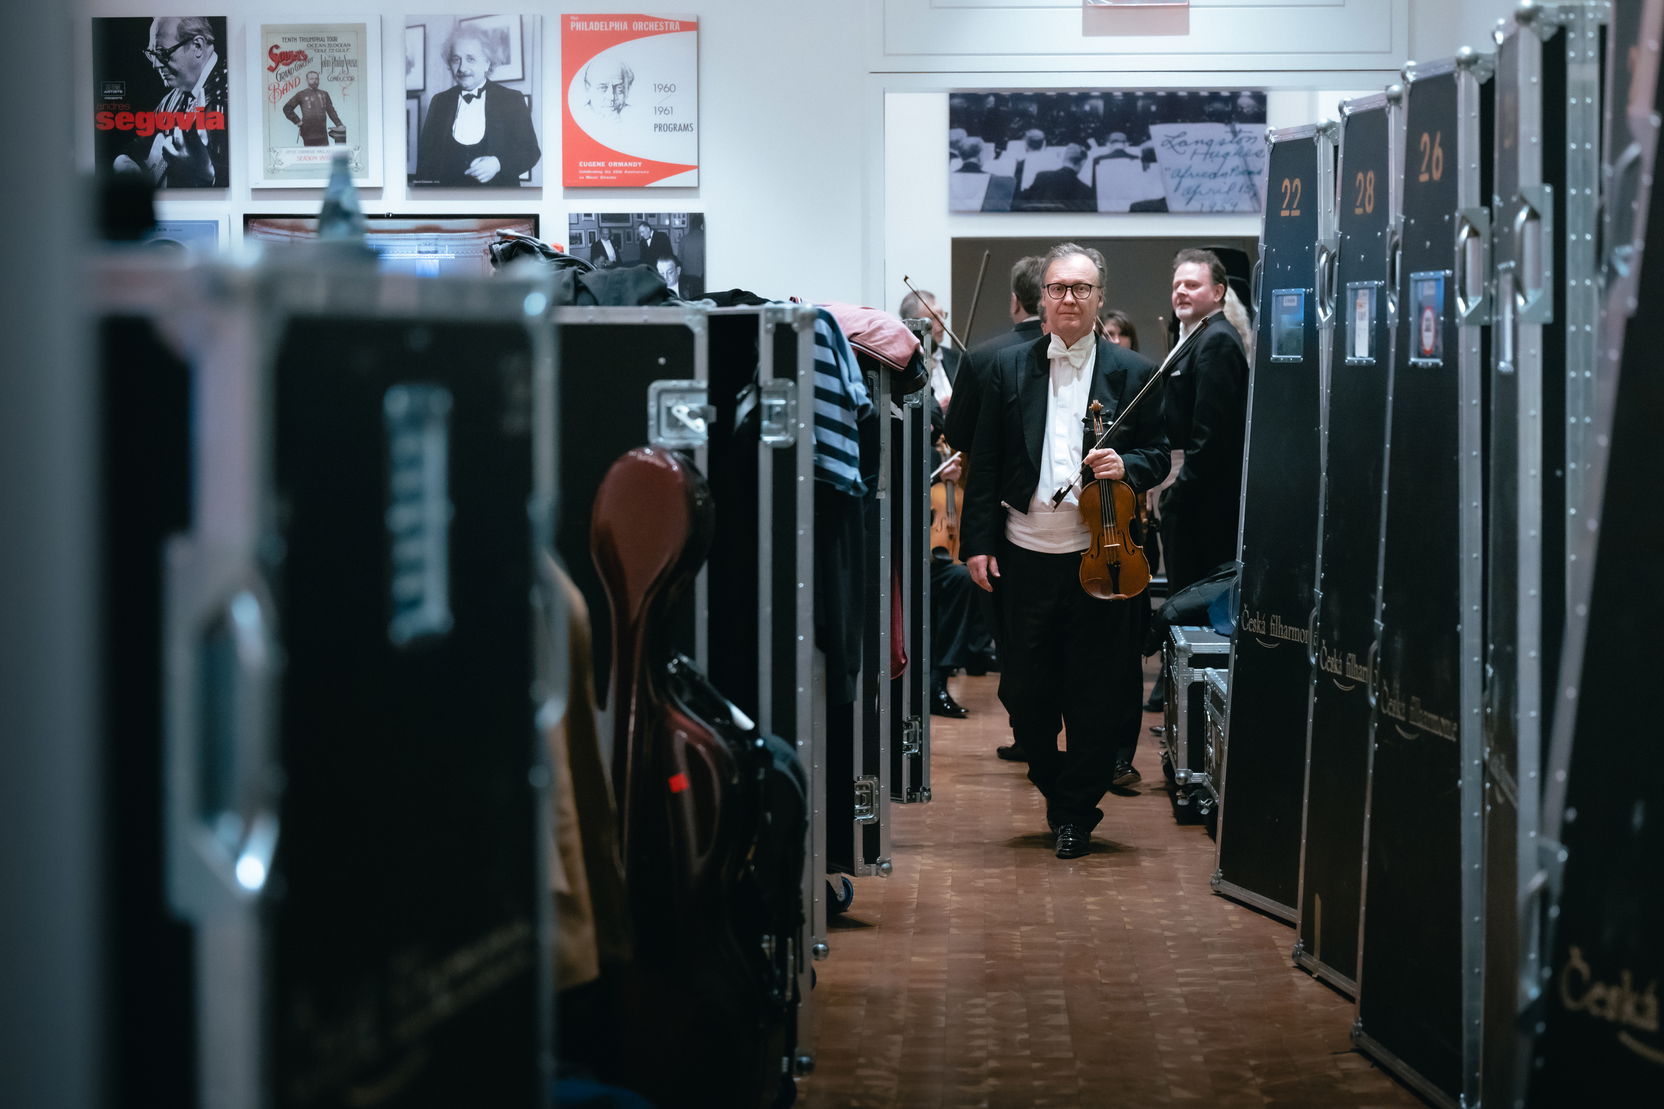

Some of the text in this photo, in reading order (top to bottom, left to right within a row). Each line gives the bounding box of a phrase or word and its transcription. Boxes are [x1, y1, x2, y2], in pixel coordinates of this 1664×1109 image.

[570, 21, 680, 31] PHILADELPHIA ORCHESTRA
[267, 76, 301, 104] BAND
[654, 83, 676, 93] 1960
[96, 106, 225, 136] segovia
[654, 106, 674, 116] 1961
[654, 123, 694, 132] PROGRAMS
[1161, 128, 1258, 155] Langston
[1418, 131, 1443, 182] 26
[1280, 178, 1301, 217] 22
[1354, 170, 1375, 215] 28
[1241, 603, 1266, 635] Česká
[1319, 639, 1343, 675] Česká
